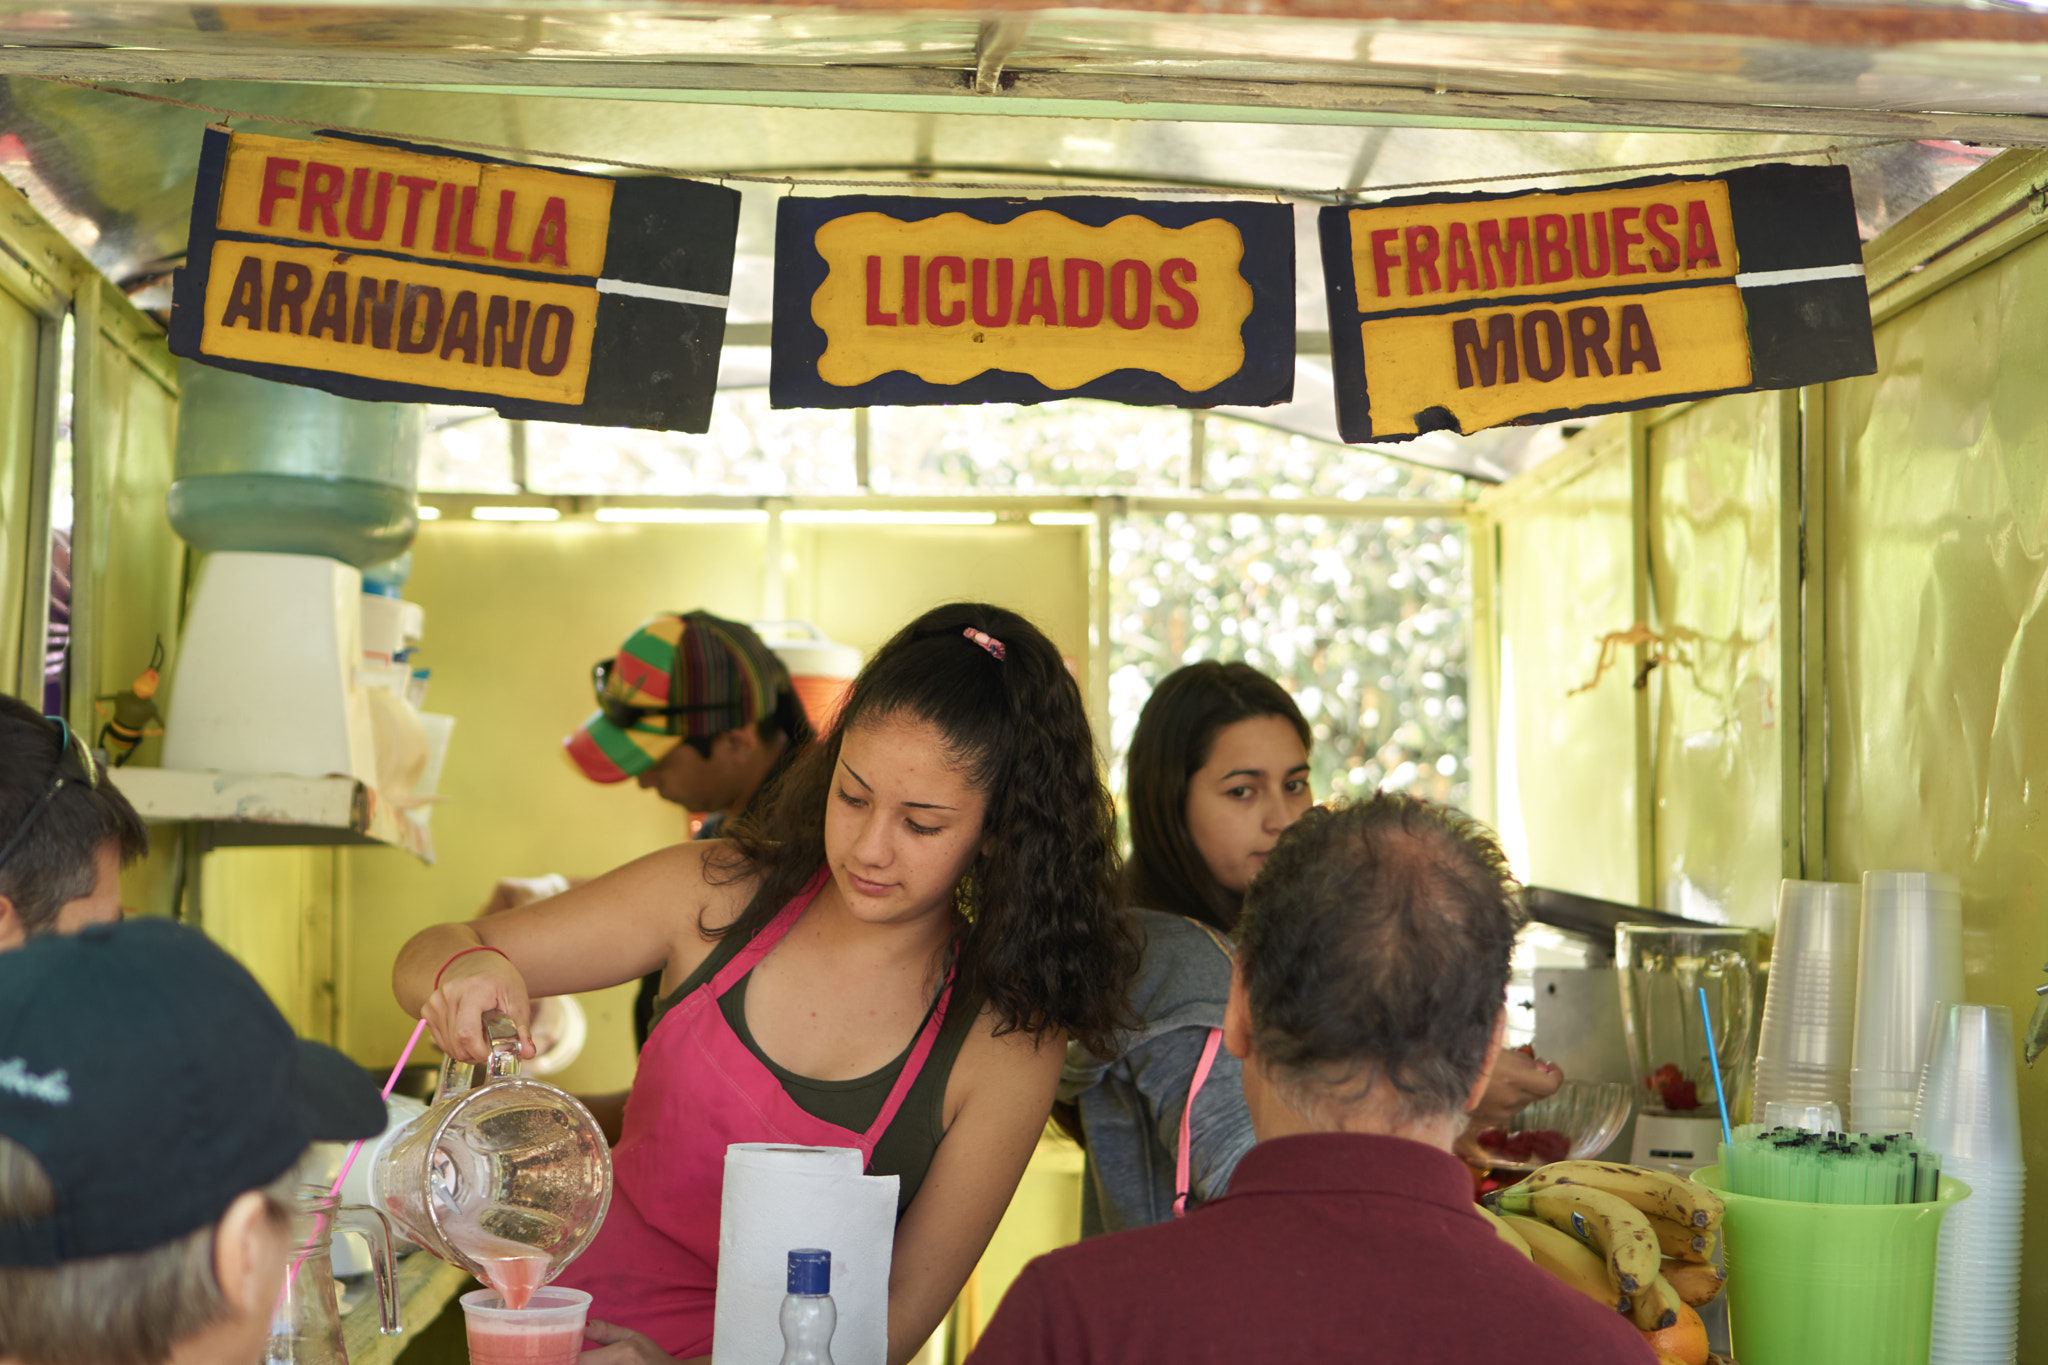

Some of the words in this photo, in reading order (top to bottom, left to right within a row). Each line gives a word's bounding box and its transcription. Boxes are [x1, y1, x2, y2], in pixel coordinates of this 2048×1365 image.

[258, 156, 569, 267] FRUTILLA
[1371, 200, 1722, 297] FRAMBUESA
[220, 255, 575, 377] ARANDANO
[865, 254, 1200, 330] LICUADOS
[1452, 303, 1661, 390] MORA
